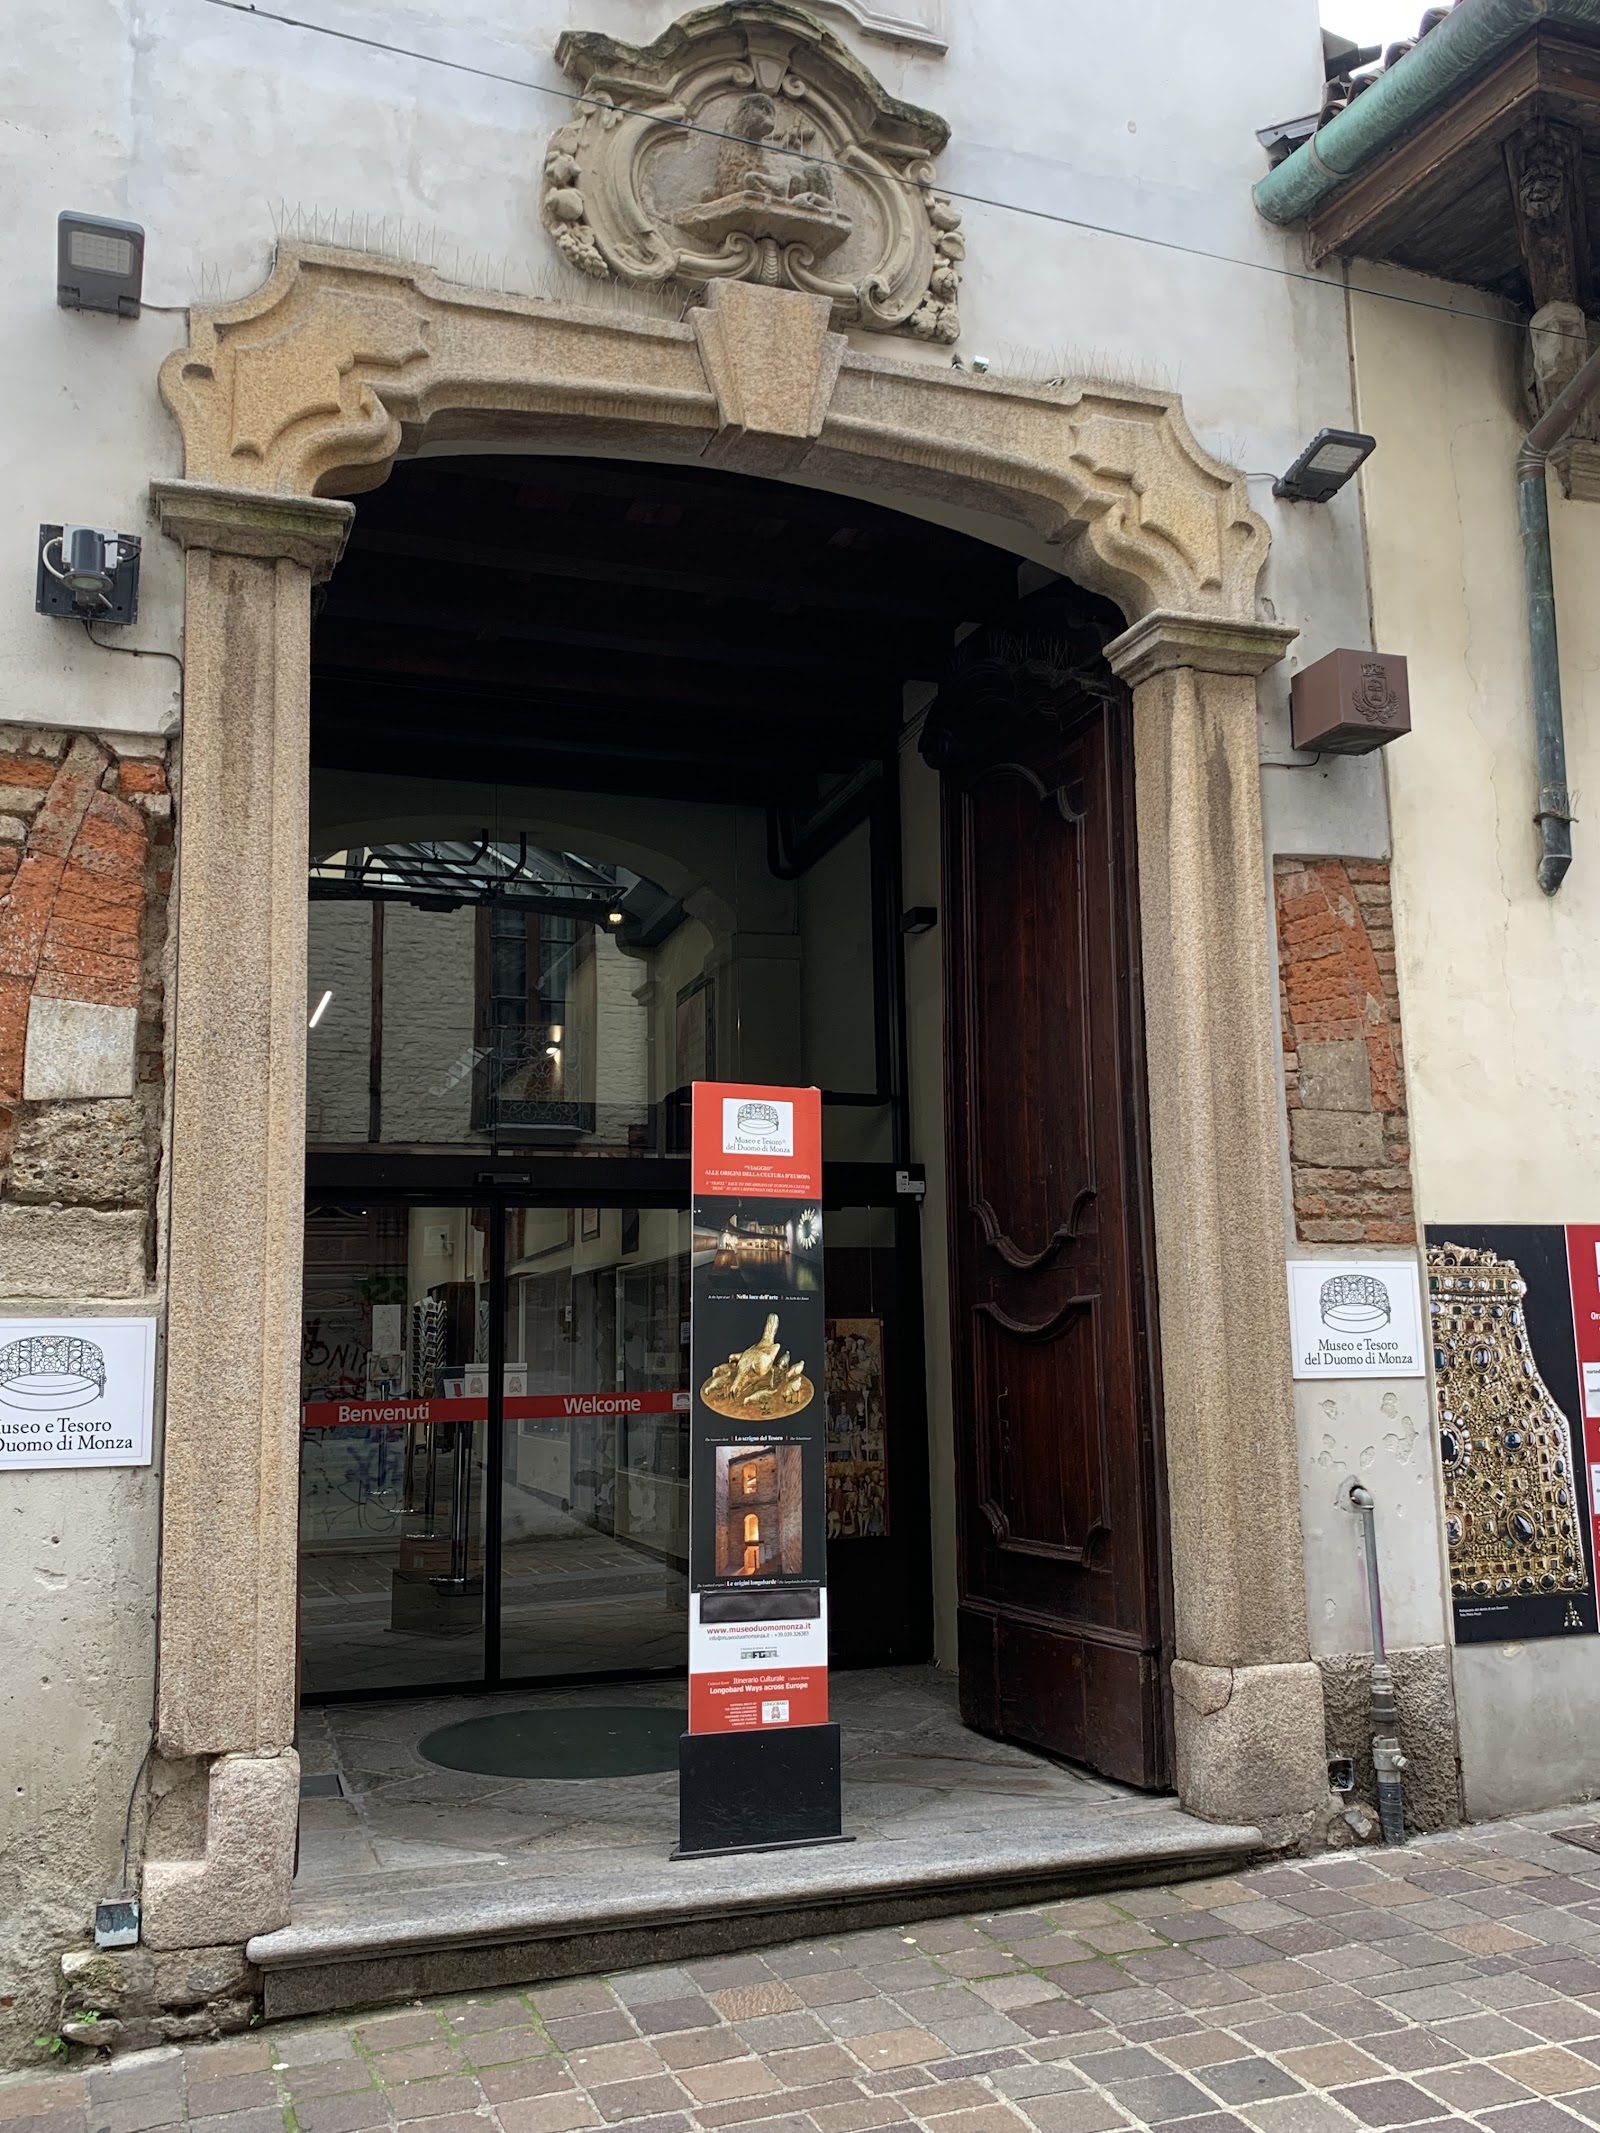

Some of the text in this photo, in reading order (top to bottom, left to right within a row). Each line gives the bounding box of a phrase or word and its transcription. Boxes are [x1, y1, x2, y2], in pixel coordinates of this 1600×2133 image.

[735, 1136, 756, 1144] Museo
[725, 1143, 736, 1151] del
[737, 1143, 761, 1152] Duomo
[769, 1145, 790, 1153] Monza
[1318, 1338, 1398, 1351] Museo e Tesoro
[1304, 1351, 1413, 1365] del Duomo di Monza
[563, 1395, 641, 1414] Welcome
[338, 1402, 430, 1423] Benvenuti
[0, 1417, 112, 1434] useo e Tesoro
[56, 1434, 72, 1451] di
[77, 1434, 133, 1450] Monza
[707, 1622, 811, 1635] www.museoduomomonza.it
[733, 1675, 785, 1685] Itinerario Culturale
[709, 1681, 808, 1695] Longobard Ways across Europe
